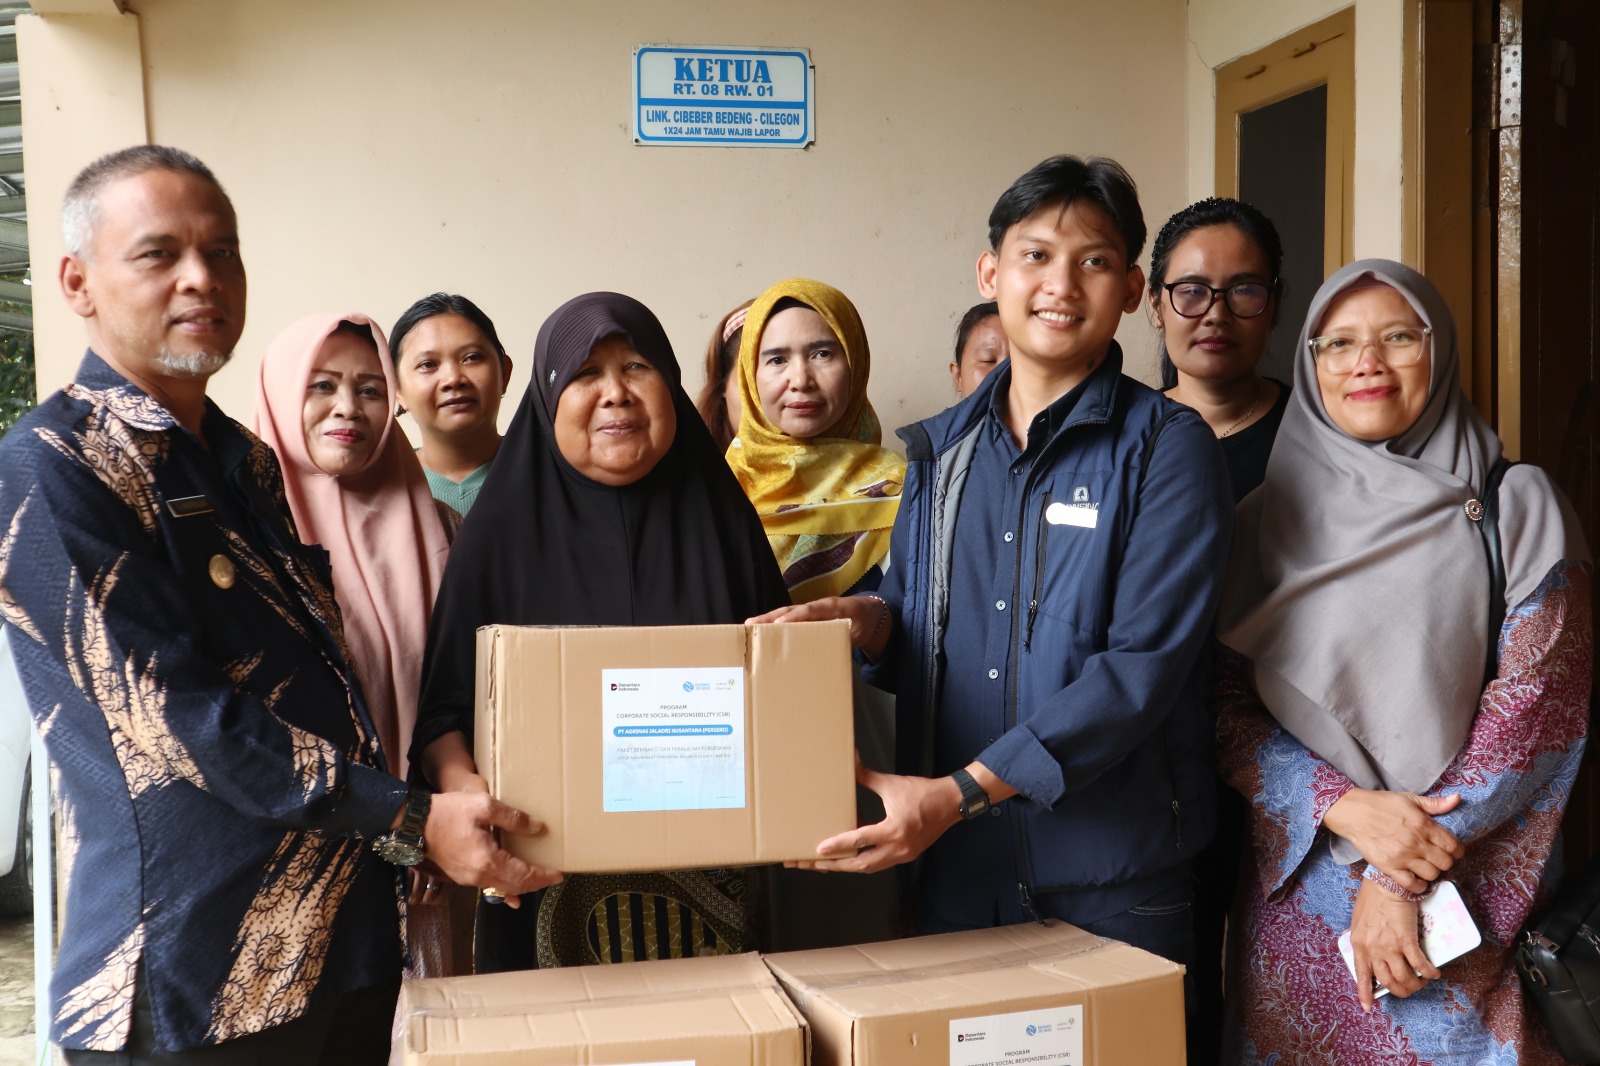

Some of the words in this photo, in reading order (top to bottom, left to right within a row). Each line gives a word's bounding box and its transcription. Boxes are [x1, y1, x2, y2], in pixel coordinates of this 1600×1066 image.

[674, 57, 772, 83] KETUA
[673, 83, 696, 95] RT.
[701, 84, 719, 96] 08
[724, 84, 752, 96] RW.
[756, 85, 773, 97] 01
[646, 110, 671, 123] LINK.
[673, 110, 713, 124] CIBEBER
[716, 111, 752, 125] BEDENG
[760, 112, 799, 126] CILEGON
[663, 127, 683, 135] 1X24
[685, 127, 701, 135] JAM
[703, 127, 726, 136] TAMU
[727, 128, 753, 136] WAJIB
[754, 128, 780, 137] LAPOR
[1004, 1049, 1031, 1057] PROGRAM
[1015, 1054, 1056, 1064] RESPONSIBILITY
